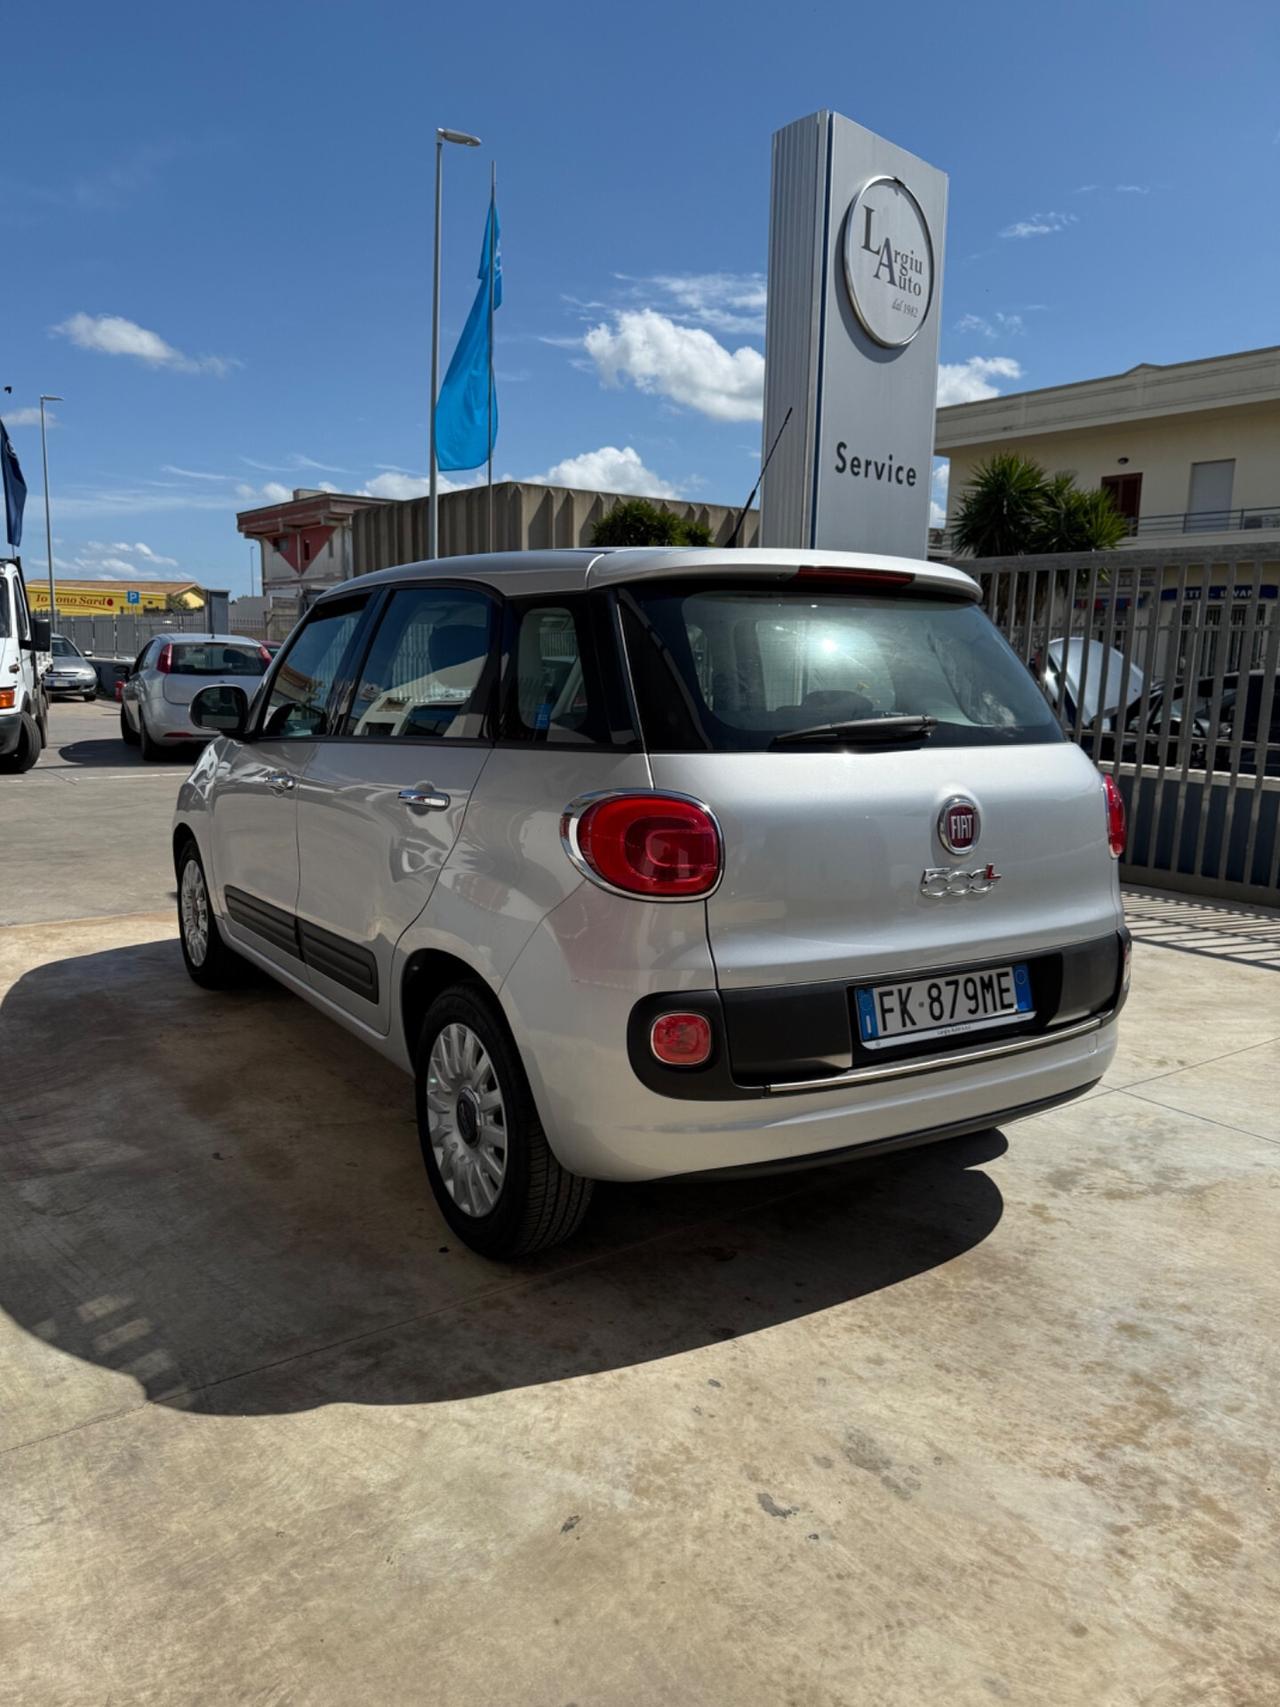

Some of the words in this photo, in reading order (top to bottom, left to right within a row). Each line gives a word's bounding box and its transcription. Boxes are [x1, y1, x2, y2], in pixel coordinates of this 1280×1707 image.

[873, 237, 923, 297] Auto
[835, 441, 917, 487] Service
[950, 815, 973, 840] FIAT
[920, 862, 1003, 899] 500L
[878, 986, 917, 1032] FK
[927, 971, 1015, 1022] 879ME
